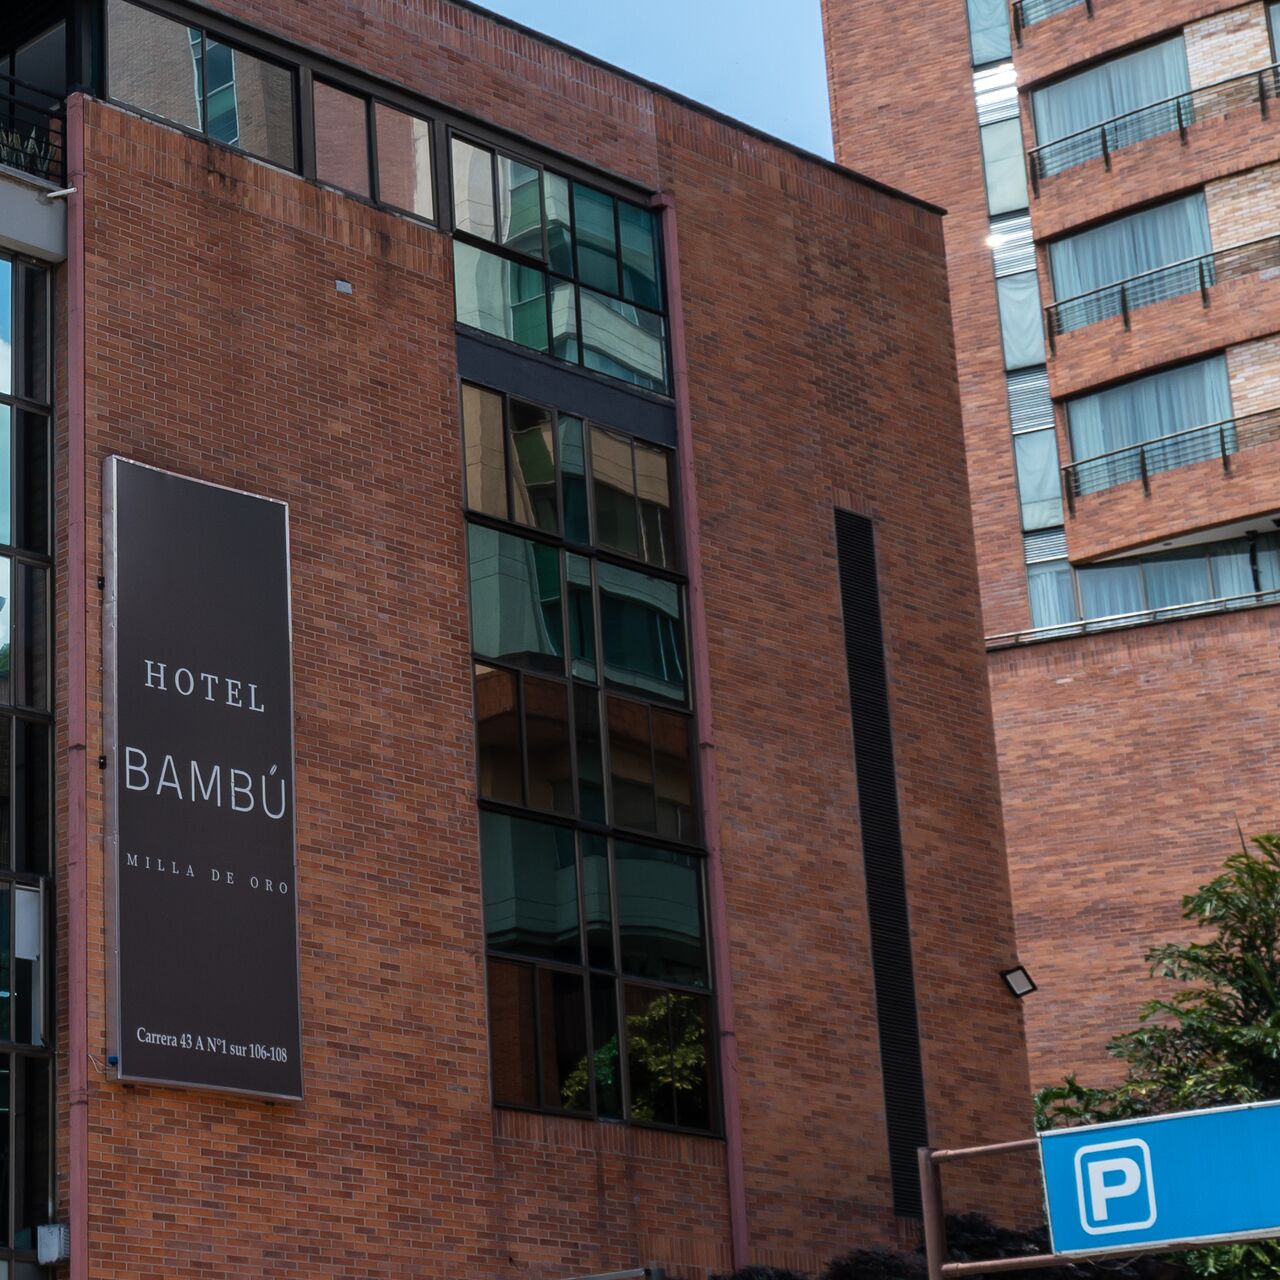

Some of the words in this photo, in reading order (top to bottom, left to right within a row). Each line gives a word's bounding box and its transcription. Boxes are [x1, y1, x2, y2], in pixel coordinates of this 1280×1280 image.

[143, 659, 265, 713] HOTEL
[125, 746, 286, 820] BAMBÚ
[126, 852, 195, 878] MILLA
[211, 868, 235, 885] DE
[250, 876, 288, 895] ORO
[136, 1026, 178, 1047] Carrera
[180, 1033, 193, 1049] 43
[195, 1035, 205, 1051] A
[230, 1043, 248, 1057] sur
[249, 1043, 288, 1063] 106-108
[1087, 1157, 1142, 1222] P
